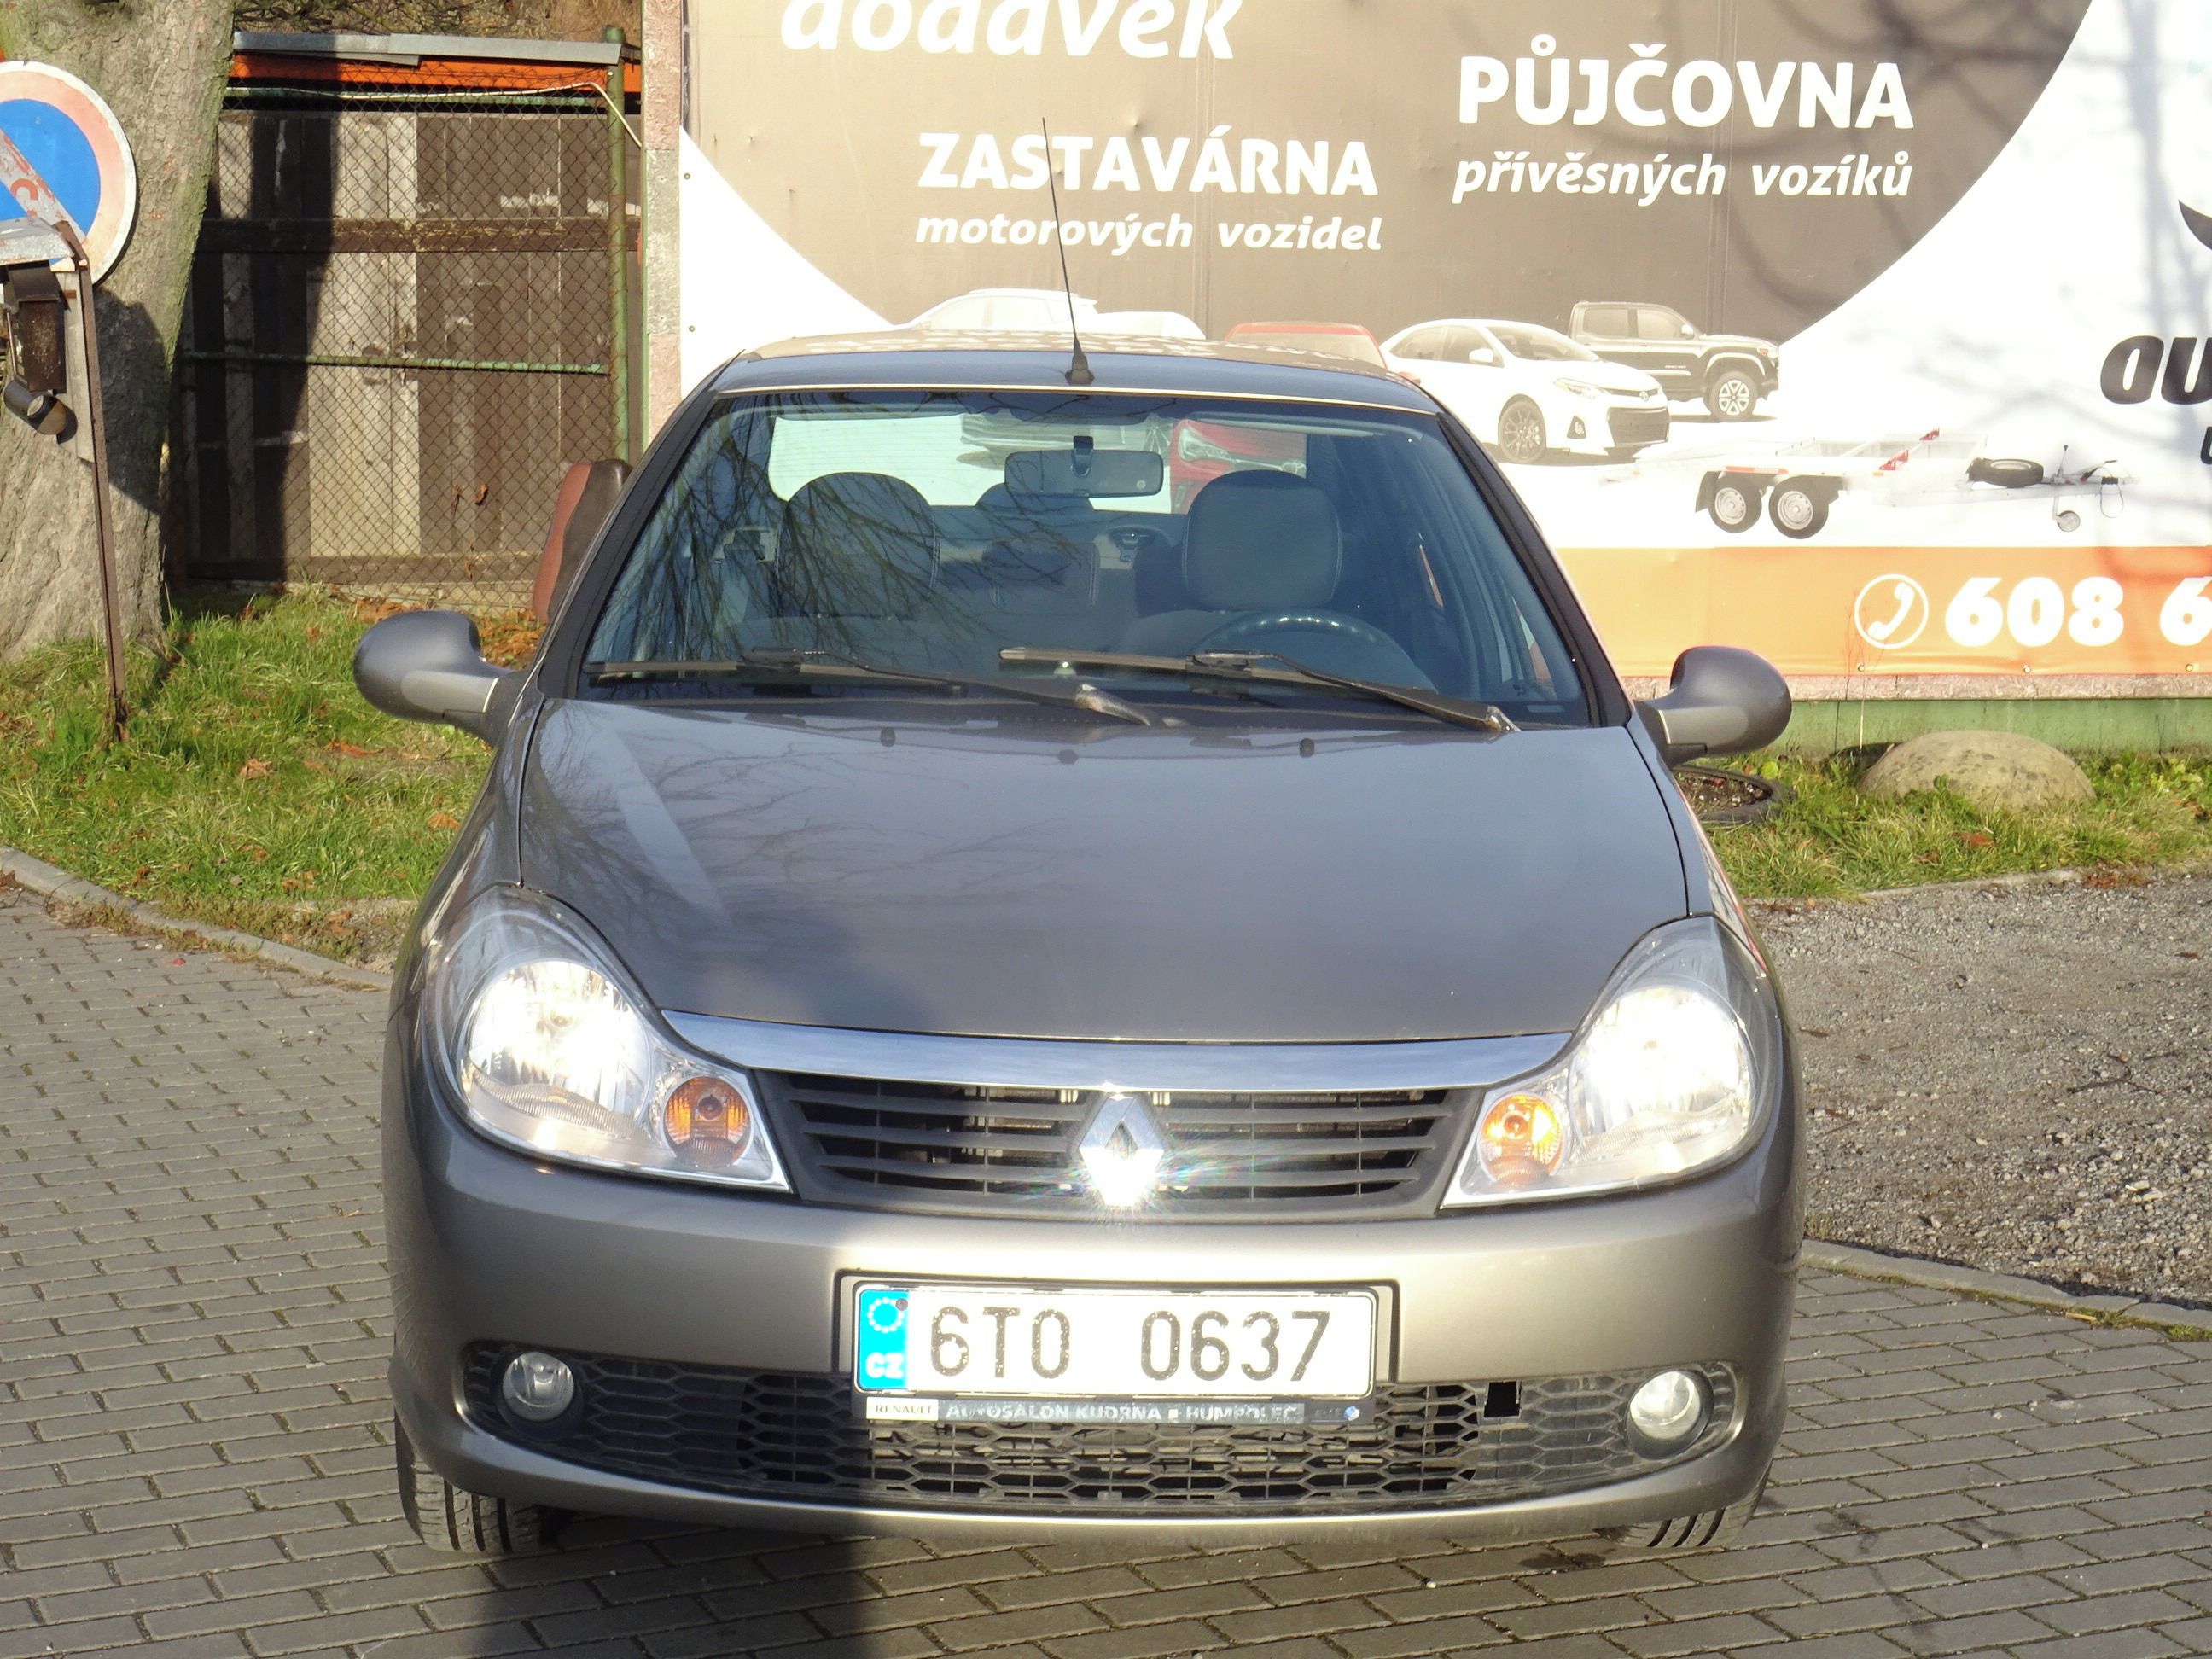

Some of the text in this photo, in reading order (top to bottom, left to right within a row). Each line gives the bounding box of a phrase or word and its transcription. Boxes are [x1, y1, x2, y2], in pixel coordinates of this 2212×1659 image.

[1458, 34, 1914, 129] PŮJČOVNA
[917, 125, 1378, 195] ZASTAVÁRNA
[1452, 150, 1912, 207] přívěsných vozíků
[915, 212, 1382, 256] motorových vozidel
[1945, 576, 2124, 647] 608
[865, 1352, 905, 1378] CZ
[1140, 1310, 1330, 1382] 0637
[875, 1404, 932, 1415] RENAULT
